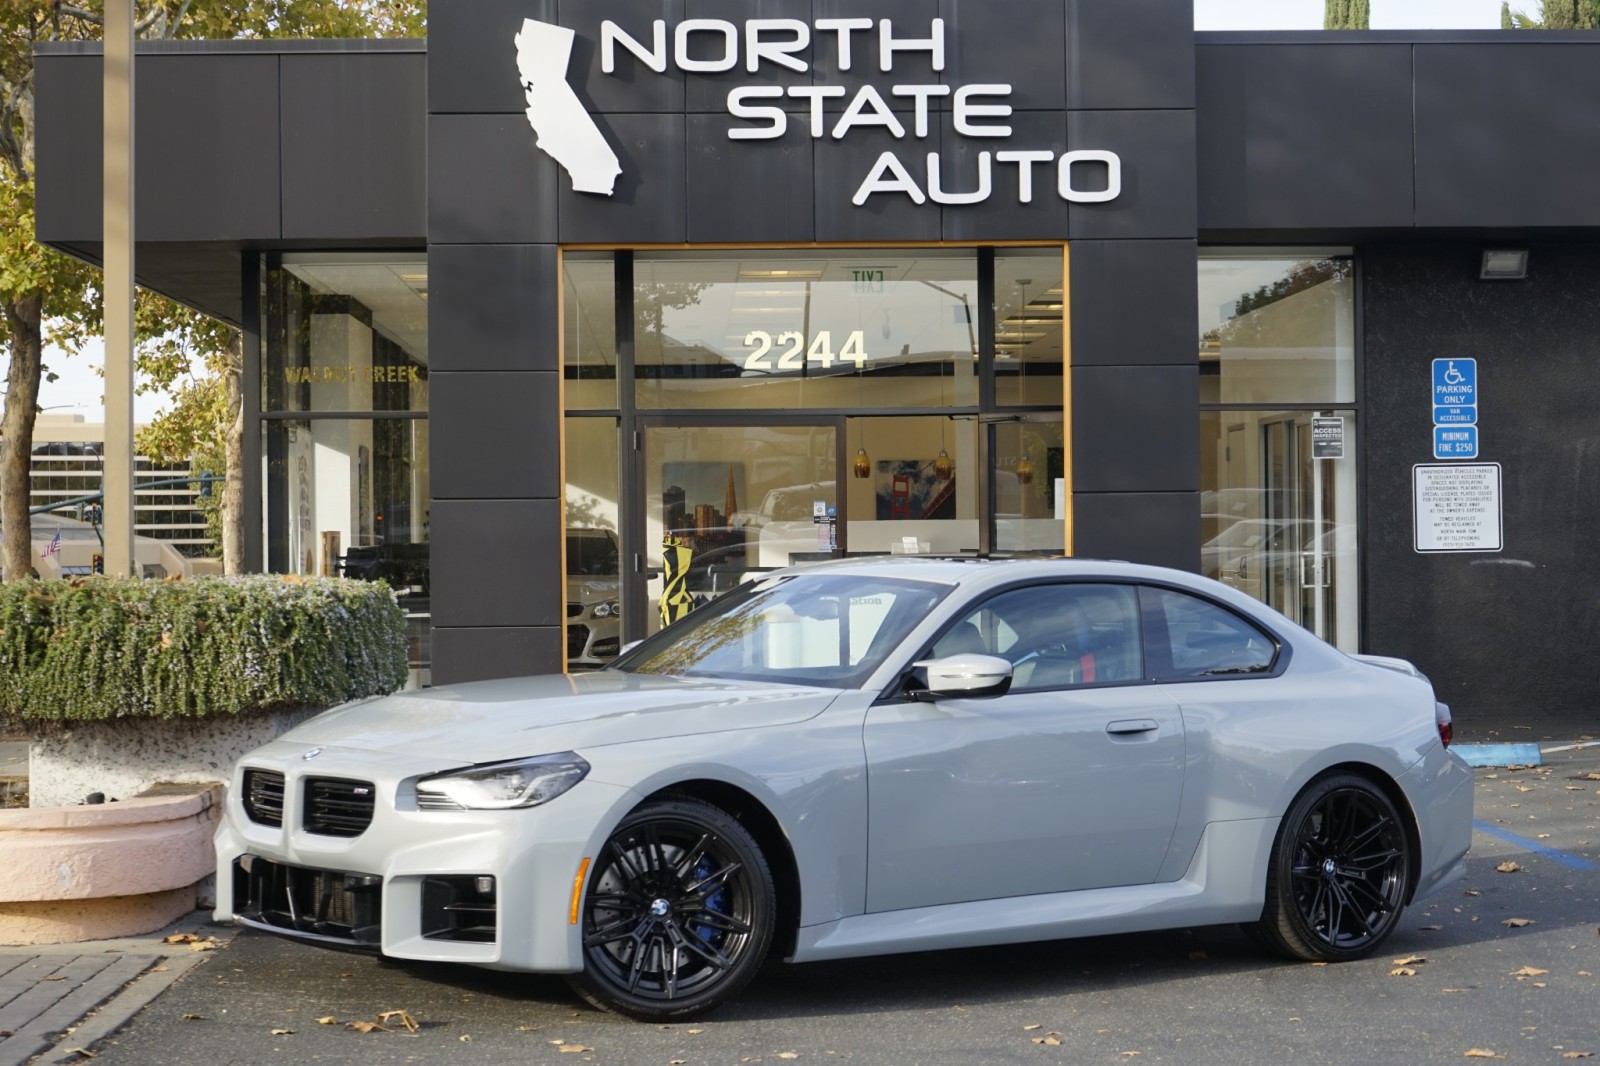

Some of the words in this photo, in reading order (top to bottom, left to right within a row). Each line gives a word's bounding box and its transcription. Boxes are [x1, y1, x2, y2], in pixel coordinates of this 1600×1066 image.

[601, 18, 945, 73] NORTH
[727, 84, 1013, 139] STATE
[852, 149, 1122, 206] AUTO
[743, 330, 869, 370] 2244
[284, 365, 357, 384] WALNUT
[361, 365, 419, 383] CREEK
[1436, 385, 1473, 394] PARKING
[1443, 395, 1466, 404] ONLY
[1442, 432, 1470, 441] MINIMUM
[1438, 443, 1453, 453] FINE
[1455, 442, 1473, 453] $250
